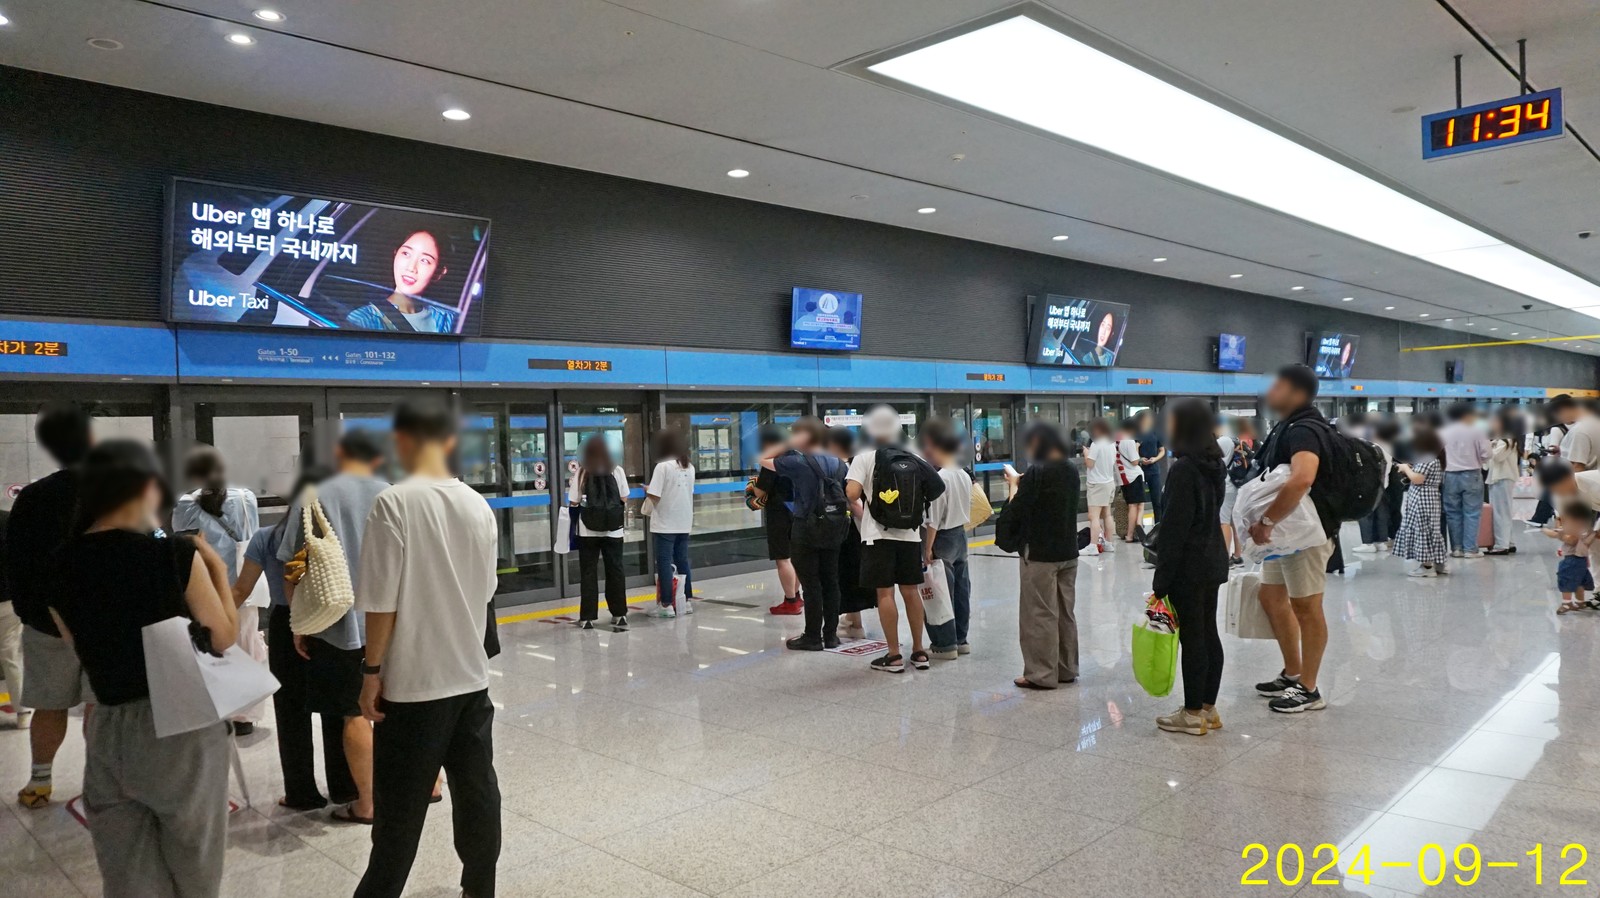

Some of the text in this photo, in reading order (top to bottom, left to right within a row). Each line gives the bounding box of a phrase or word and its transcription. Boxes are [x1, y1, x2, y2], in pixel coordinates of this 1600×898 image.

[1446, 99, 1550, 147] 11:34
[191, 202, 336, 235] Uber 앱 하나로
[191, 227, 358, 264] 해외부터 국내까지
[188, 289, 269, 310] Uber Taxi
[34, 342, 60, 356] 2분
[279, 347, 299, 356] 1-50
[364, 350, 396, 359] 101-132
[566, 360, 608, 371] 열차가 2분
